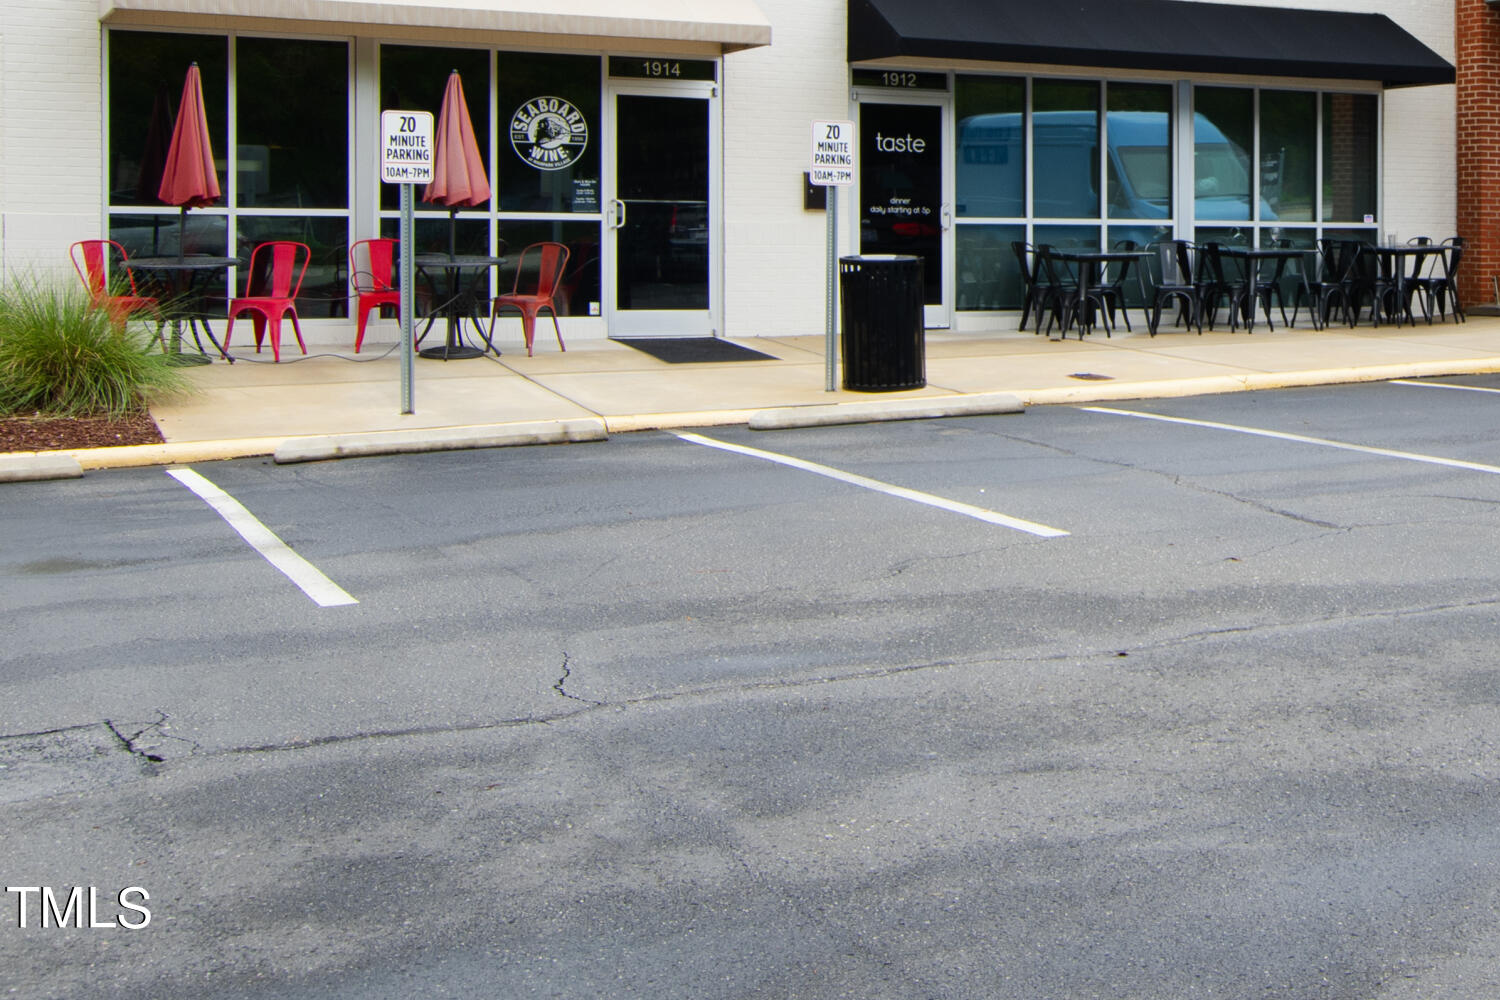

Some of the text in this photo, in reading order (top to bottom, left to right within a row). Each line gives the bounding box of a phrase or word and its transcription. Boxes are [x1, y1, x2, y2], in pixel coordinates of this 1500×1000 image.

[643, 61, 681, 77] 1914
[882, 72, 917, 87] 1912
[513, 98, 586, 133] SEABOARD
[400, 116, 416, 133] 20
[826, 125, 840, 139] 20
[390, 134, 426, 147] MINUTE
[817, 141, 848, 152] MINUTE
[876, 132, 926, 153] taste
[386, 148, 429, 161] PARKING
[531, 145, 568, 161] WINE
[814, 153, 851, 165] PARKING
[386, 166, 430, 179] 10AM-7PM
